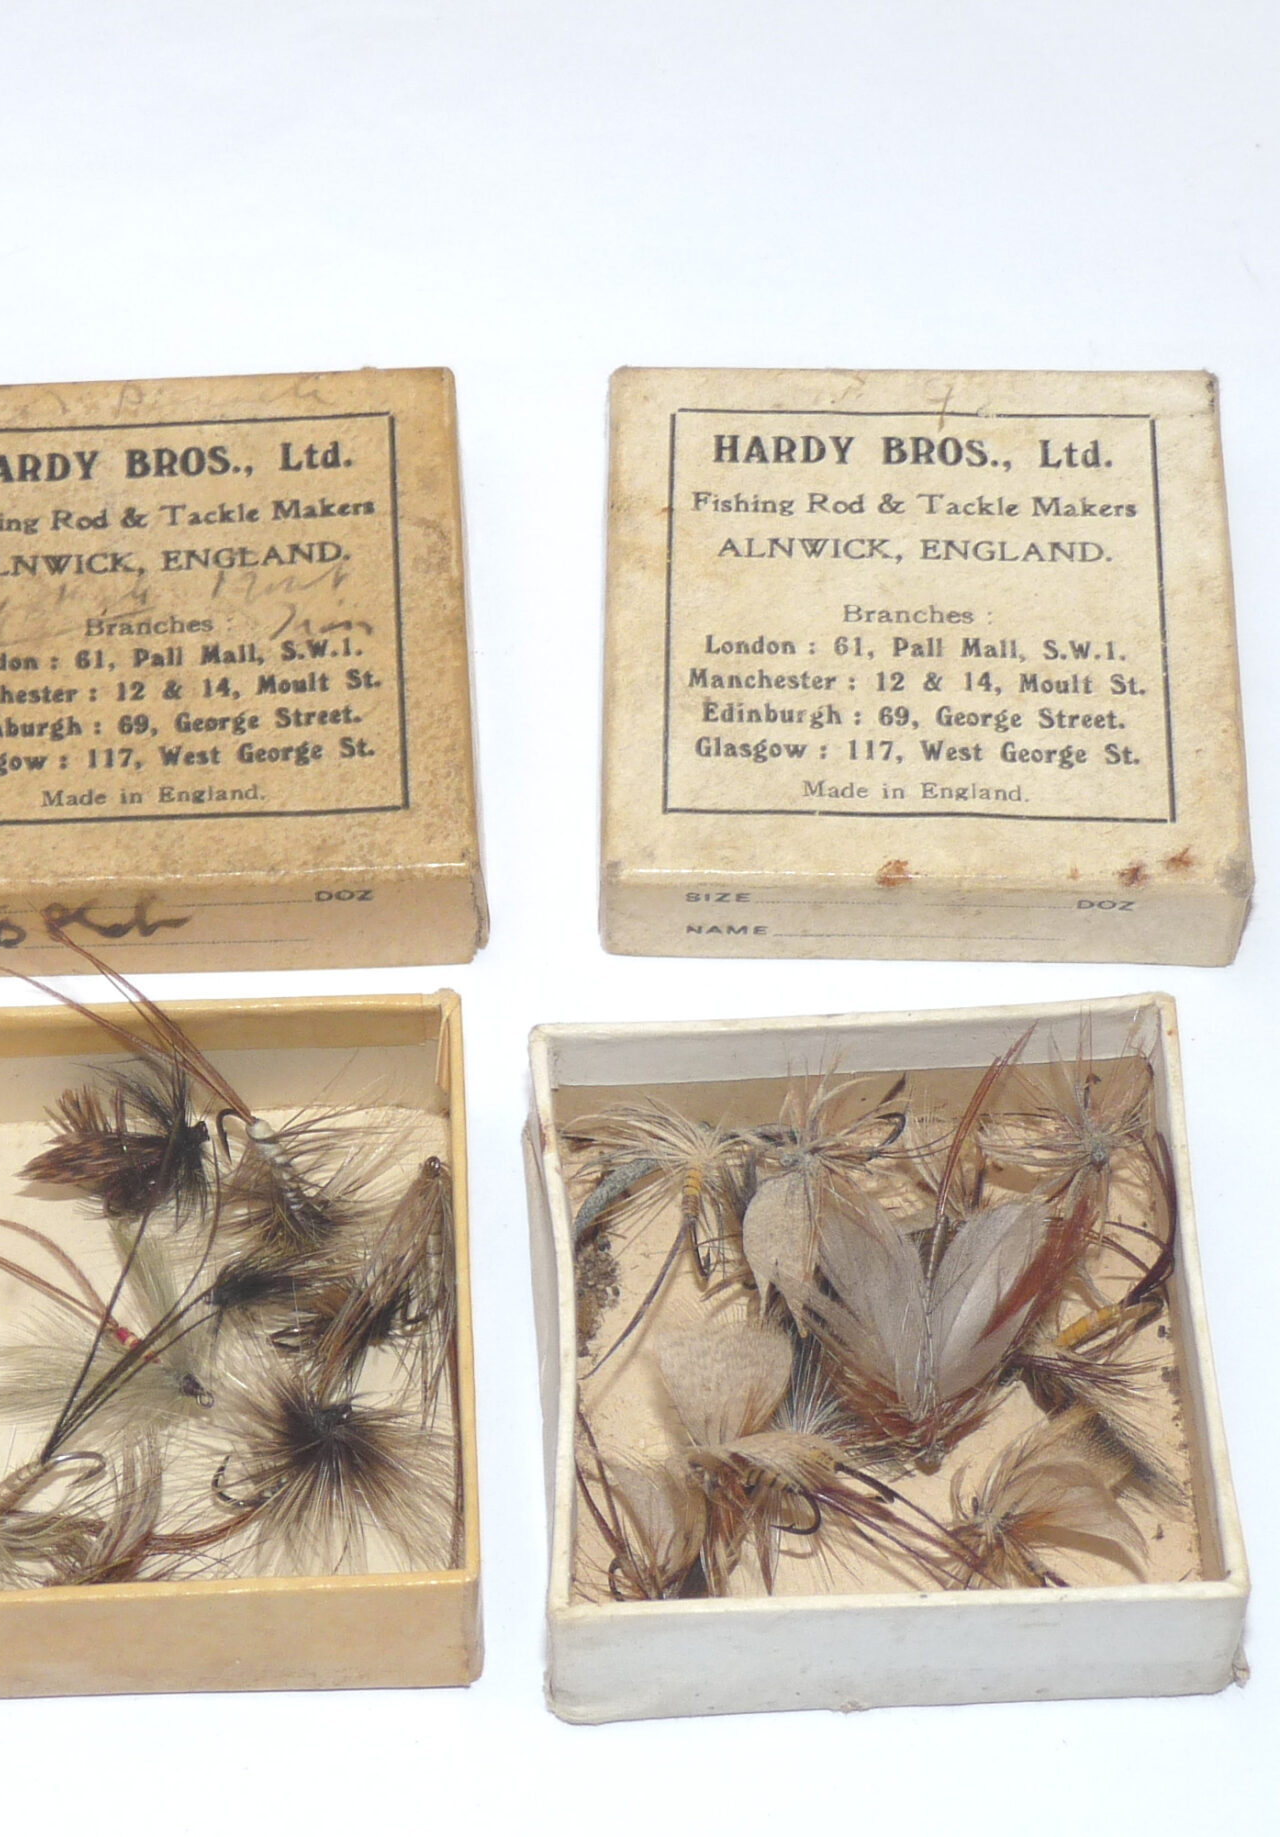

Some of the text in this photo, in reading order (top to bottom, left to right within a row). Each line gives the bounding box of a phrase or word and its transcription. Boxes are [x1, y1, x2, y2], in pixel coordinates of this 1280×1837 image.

[126, 446, 253, 479] BROS.,
[279, 441, 352, 471] Ltd.
[714, 435, 1112, 472] HARDY BROS., Ltd.
[51, 508, 109, 531] Rod
[120, 507, 147, 528] &
[159, 503, 259, 526] Tackle
[272, 498, 375, 520] Makers
[692, 491, 1137, 517] Fishing Rod & Tackle Makers
[161, 541, 350, 571] ENGLAND.
[717, 538, 1112, 564] ALNWICK, ENGLAND.
[75, 650, 115, 671] 61,
[133, 646, 182, 668] Pall
[200, 643, 264, 665] Mall,
[834, 636, 874, 660] 61,
[893, 637, 942, 657] Pall
[961, 638, 1026, 662] Mall,
[117, 681, 145, 701] 12
[162, 679, 183, 700] &
[204, 677, 240, 700] 14,
[256, 672, 329, 695] Moult
[346, 669, 381, 690] St.
[877, 671, 904, 692] 12
[923, 672, 943, 692] &
[965, 671, 1001, 696] 14,
[1019, 673, 1092, 694] Moult
[1111, 674, 1146, 695] St.
[118, 714, 158, 737] 69,
[175, 711, 259, 735] George
[275, 705, 362, 728] Street.
[878, 706, 919, 730] 69,
[936, 706, 1022, 733] George
[1039, 707, 1125, 729] Street.
[88, 748, 143, 770] 117,
[158, 745, 220, 766] West
[237, 741, 323, 766] George
[340, 736, 375, 758] St.
[849, 739, 903, 764] 117,
[920, 740, 983, 761] West
[1000, 741, 1087, 769] George
[1105, 743, 1140, 765] St.
[41, 784, 265, 807] Made in England.
[803, 780, 1029, 802] Made in England.
[315, 889, 373, 902] DOZ
[685, 892, 1135, 911] SIZE DOZ
[686, 925, 768, 935] NAME
